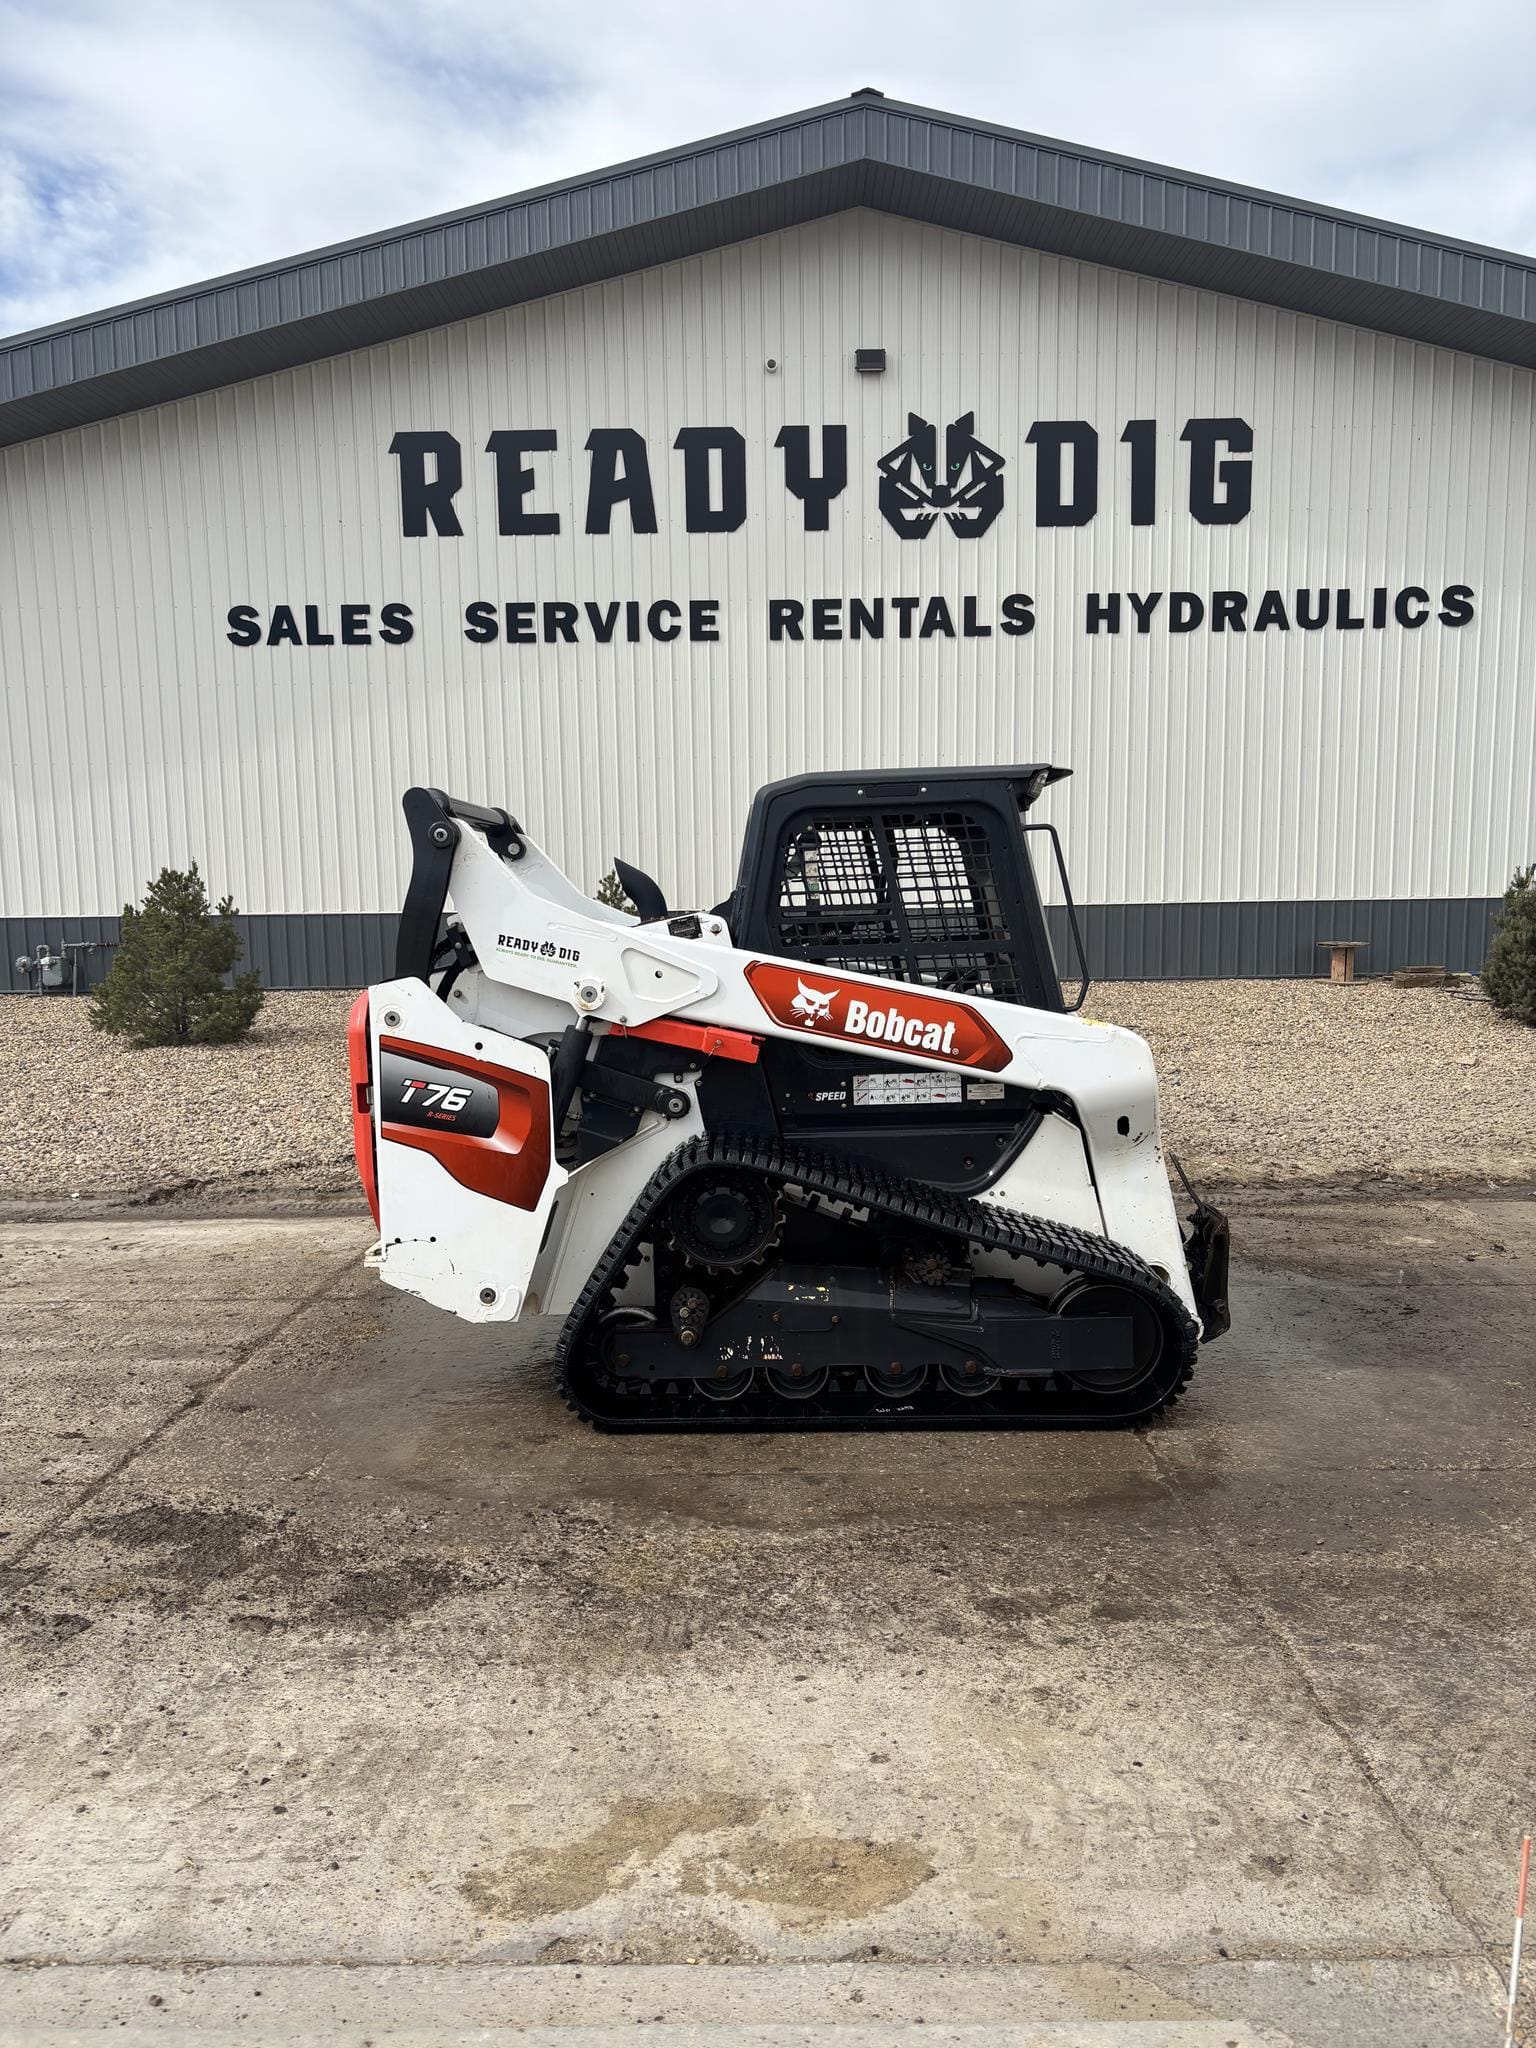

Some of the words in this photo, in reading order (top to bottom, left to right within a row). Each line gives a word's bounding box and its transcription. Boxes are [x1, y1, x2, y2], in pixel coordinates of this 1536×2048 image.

[389, 425, 847, 537] READY
[1025, 418, 1253, 527] DIG
[227, 603, 413, 646] SALES
[464, 600, 719, 643] SERVICE
[770, 594, 1035, 640] RENTALS
[1087, 585, 1474, 634] HYDRAULICS
[497, 934, 539, 953] READY
[558, 947, 580, 962] DIG
[844, 999, 956, 1054] Bobcat
[401, 1079, 473, 1112] T76
[815, 1091, 847, 1102] SPEED
[427, 1111, 457, 1121] R-SERIES
